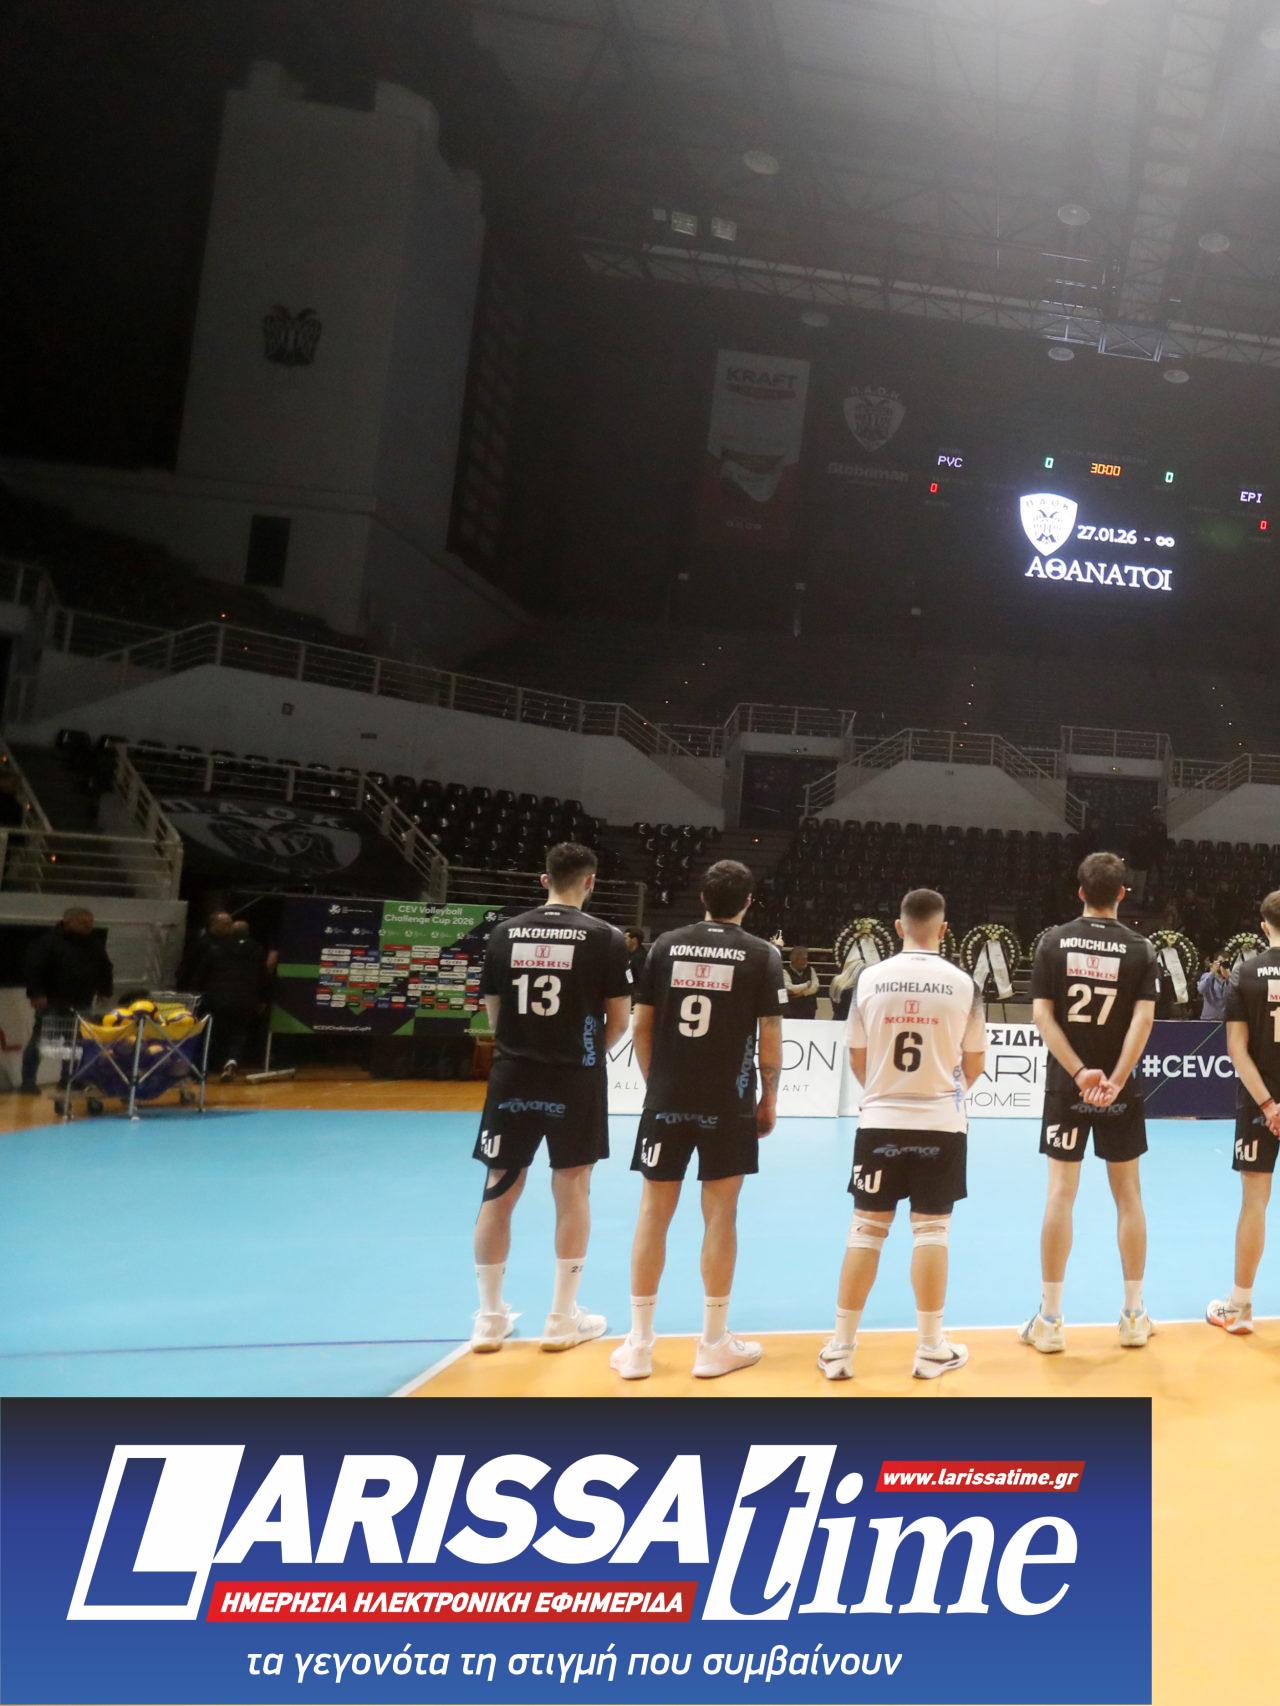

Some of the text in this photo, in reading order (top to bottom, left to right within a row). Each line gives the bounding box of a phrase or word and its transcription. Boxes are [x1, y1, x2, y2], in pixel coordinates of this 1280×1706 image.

[937, 456, 963, 468] PVC
[1044, 457, 1054, 469] 0
[1164, 471, 1174, 483] 0
[929, 482, 938, 493] 0
[1240, 491, 1263, 504] EPI
[1260, 520, 1268, 530] 0
[1077, 525, 1137, 545] 27.01.26
[1024, 556, 1173, 591] ΑΘΑΝΑΤΟΙ
[398, 905, 463, 916] CEV Volleyball
[384, 914, 474, 925] Challenge Cup 2026
[508, 927, 587, 941] TAKOURIDIS
[1060, 938, 1127, 953] MOUCHLIAS
[670, 945, 746, 961] KOKKINAKIS
[513, 959, 570, 968] MORRIS
[1068, 968, 1117, 980] MORRIS
[673, 979, 730, 989] MORRIS
[875, 982, 953, 995] MICHELAKIS
[512, 974, 561, 1016] 13
[1067, 983, 1118, 1026] 27
[679, 995, 712, 1037] 9
[884, 1016, 940, 1025] MORRIS
[893, 1031, 923, 1072] 6
[1046, 1124, 1078, 1150] F&U
